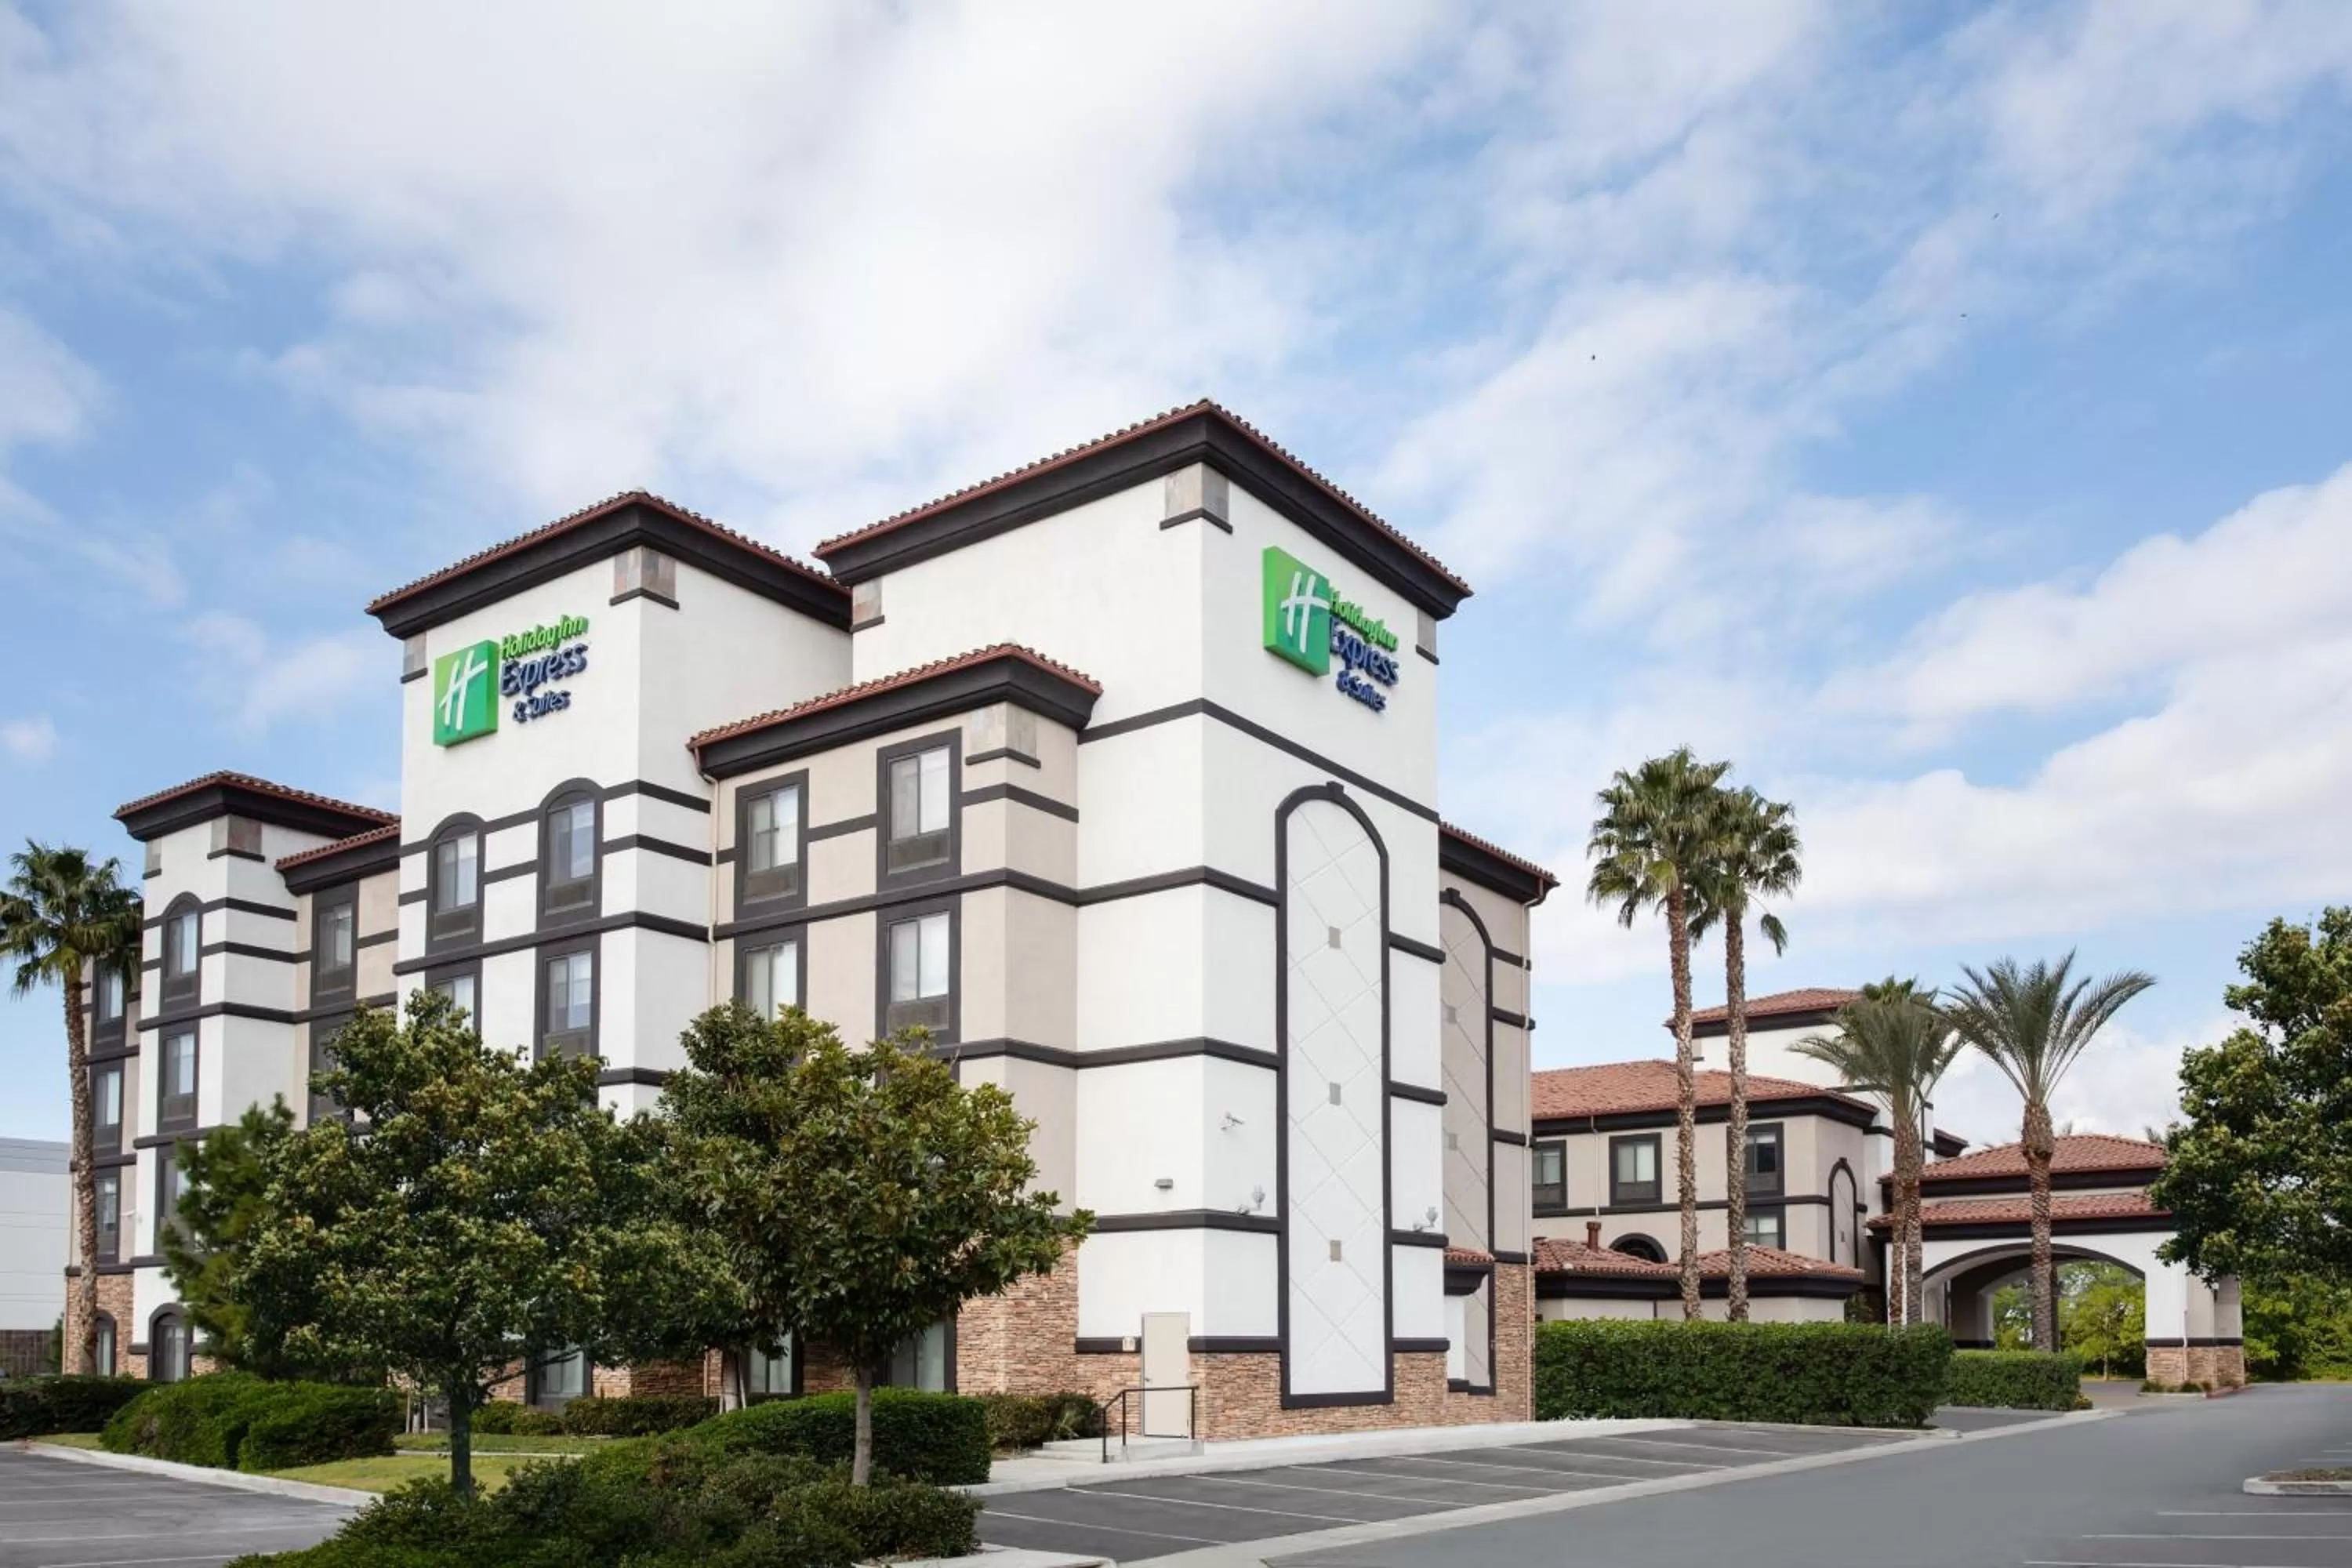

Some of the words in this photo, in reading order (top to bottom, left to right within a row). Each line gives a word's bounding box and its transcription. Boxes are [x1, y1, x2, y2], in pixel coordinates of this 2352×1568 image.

[560, 615, 590, 640] Inn
[501, 643, 588, 697] Express
[1330, 615, 1399, 687] Express
[513, 701, 528, 724] &
[528, 690, 572, 720] Suites
